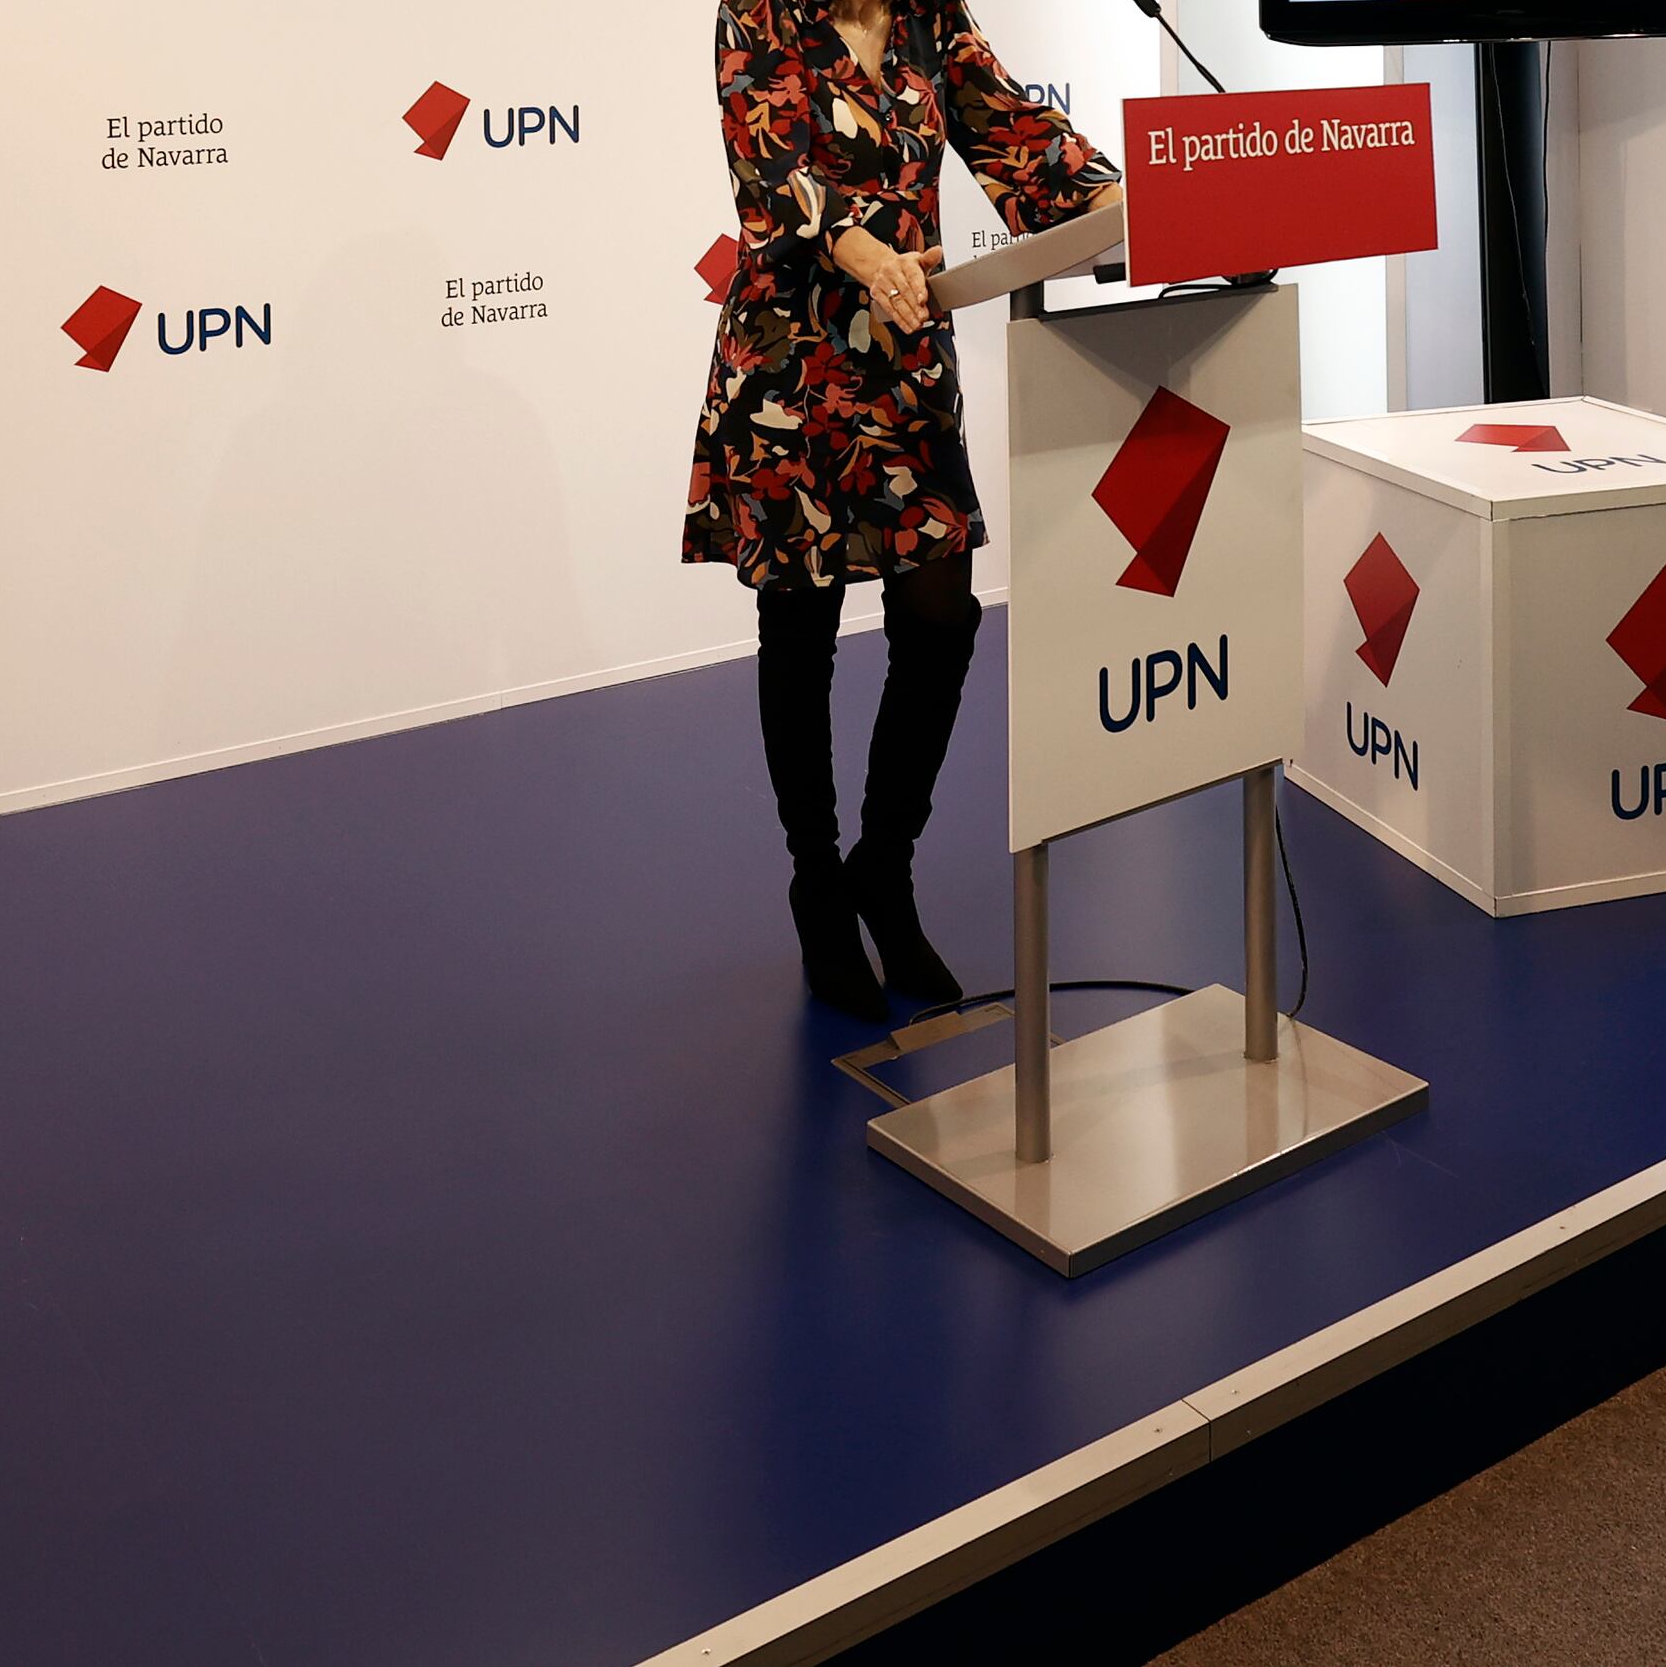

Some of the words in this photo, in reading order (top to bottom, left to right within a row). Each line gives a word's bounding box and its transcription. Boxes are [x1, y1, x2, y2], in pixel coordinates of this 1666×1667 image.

[1025, 83, 1070, 116] PN
[107, 117, 130, 138] El
[138, 113, 222, 142] partido
[484, 105, 579, 148] UPN
[102, 148, 128, 169] de
[138, 147, 228, 167] Navarra
[1148, 127, 1176, 164] El
[1182, 122, 1277, 171] partido
[1285, 120, 1313, 154] de
[1321, 119, 1415, 151] Navarra
[972, 230, 986, 248] El
[445, 278, 466, 299] El
[471, 272, 544, 301] partido
[158, 303, 271, 355] UPN
[441, 307, 464, 327] de
[471, 302, 548, 325] Navarra
[1099, 634, 1228, 733] UPN
[1347, 702, 1418, 790] UPN
